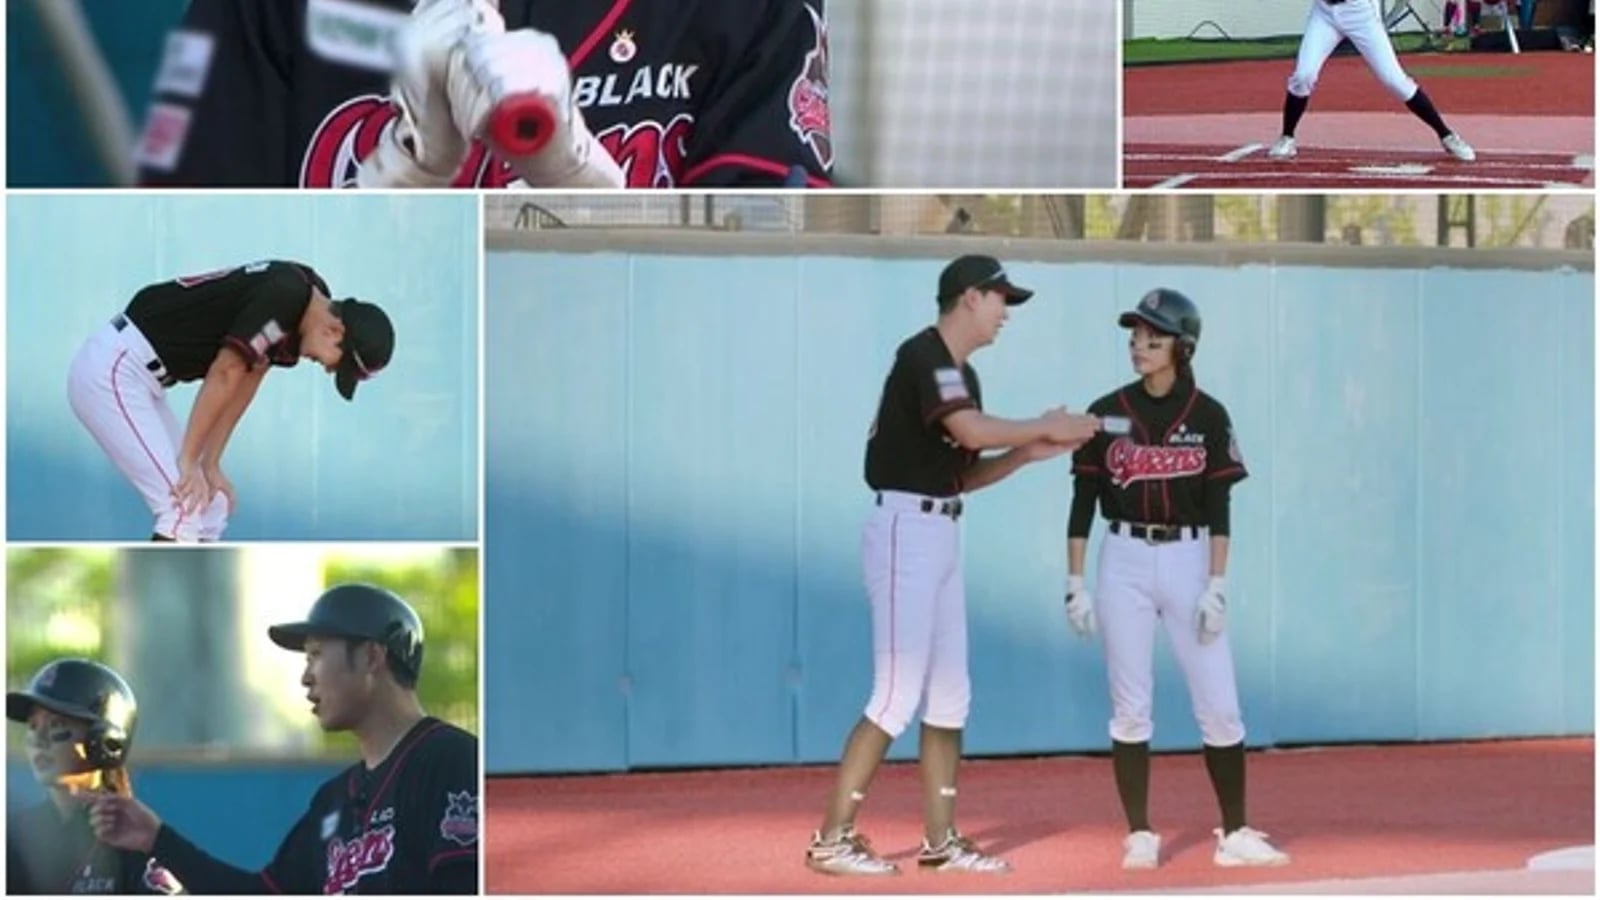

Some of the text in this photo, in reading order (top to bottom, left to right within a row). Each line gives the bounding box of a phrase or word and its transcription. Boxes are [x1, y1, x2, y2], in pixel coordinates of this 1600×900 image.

[573, 62, 698, 108] BLACK
[1168, 433, 1206, 443] BLACK
[1107, 437, 1207, 489] Queens
